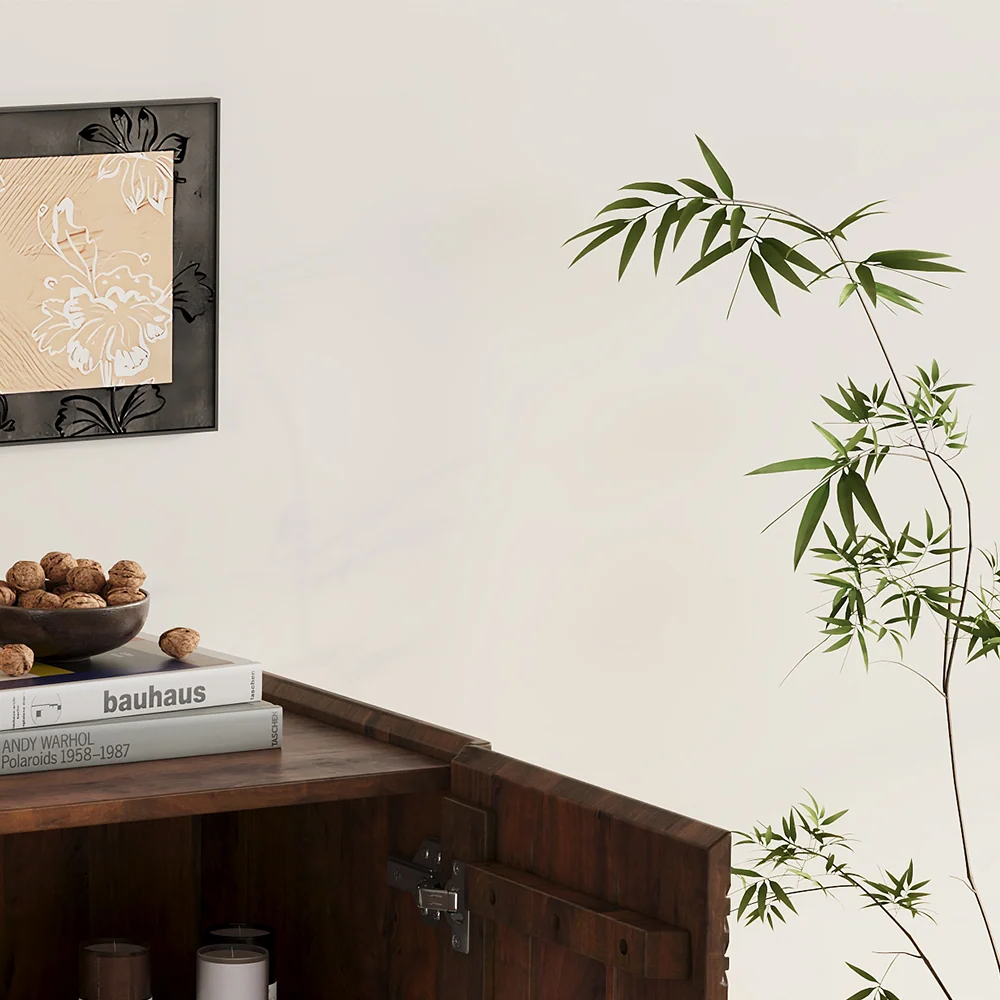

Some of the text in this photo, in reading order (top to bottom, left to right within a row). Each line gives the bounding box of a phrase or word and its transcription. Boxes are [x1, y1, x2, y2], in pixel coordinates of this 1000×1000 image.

[103, 685, 206, 713] bauhaus
[271, 711, 279, 747] TASCHEN
[2, 732, 94, 754] ANDY WARHOL
[1, 751, 58, 769] Polaroids
